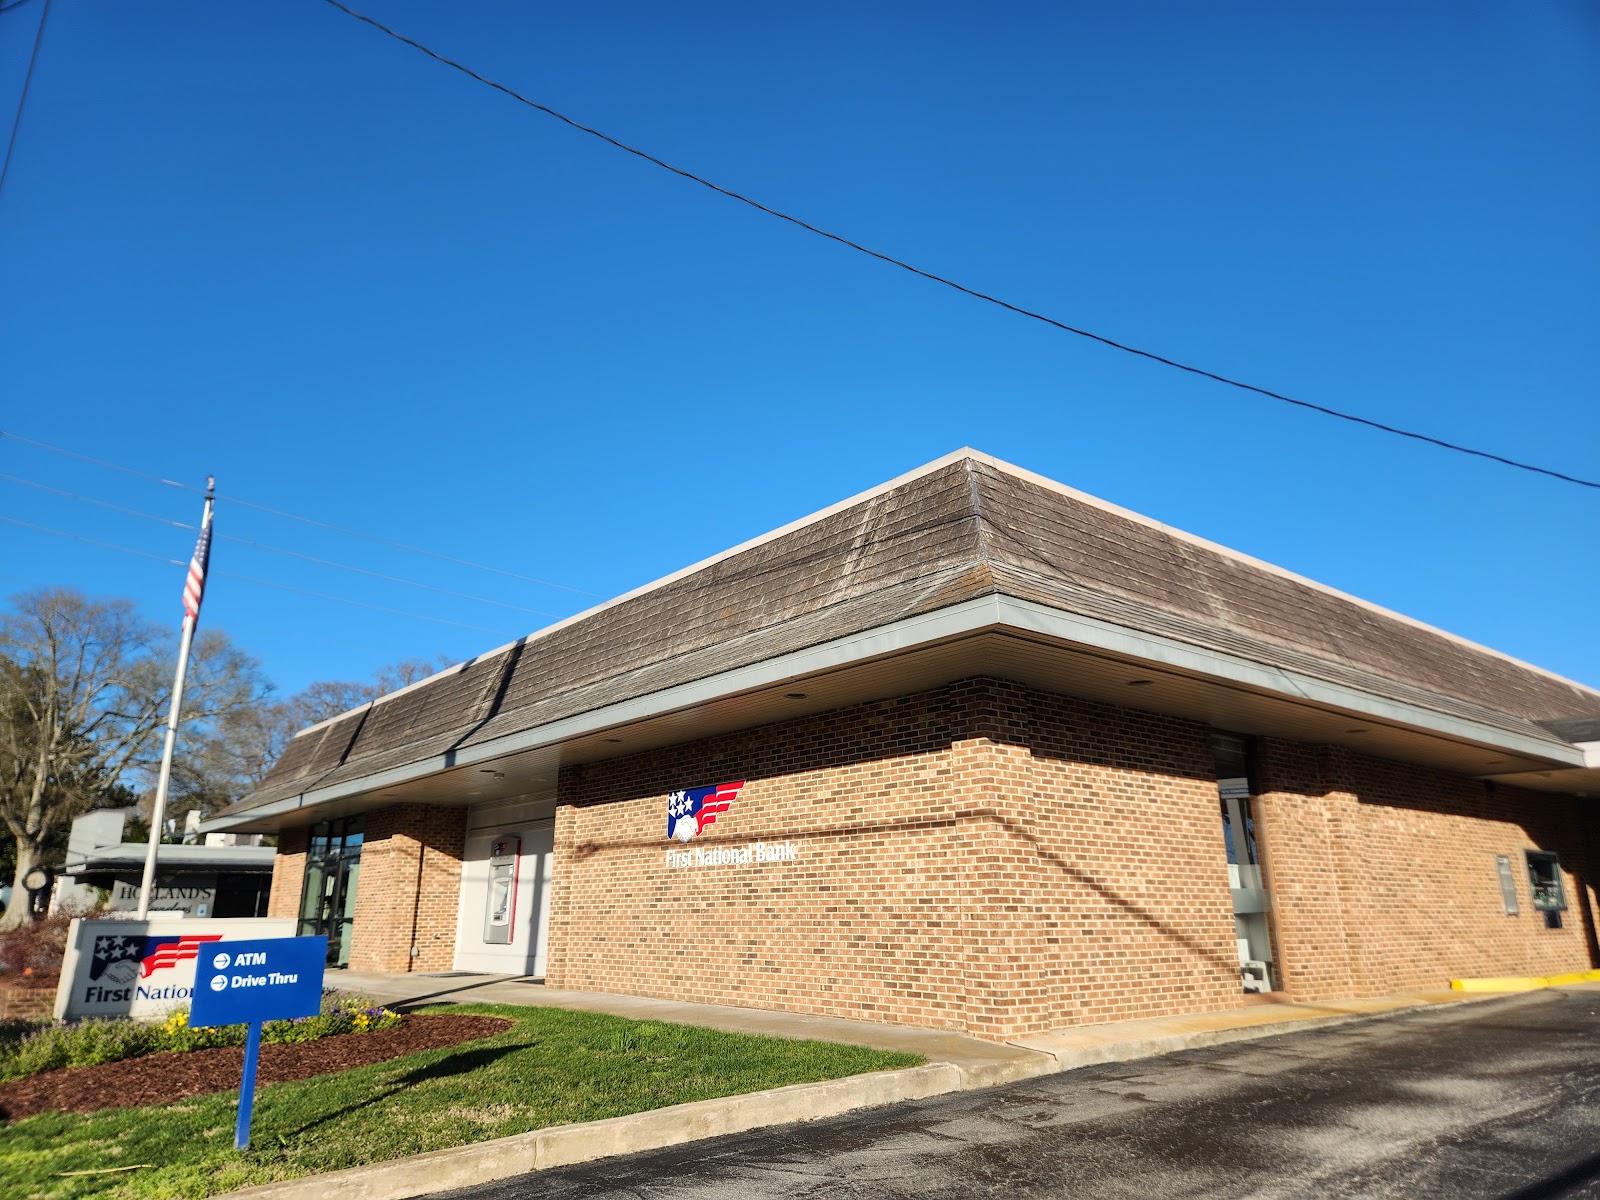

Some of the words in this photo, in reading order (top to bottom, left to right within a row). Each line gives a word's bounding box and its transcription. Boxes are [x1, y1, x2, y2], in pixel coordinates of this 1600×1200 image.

[666, 848, 692, 868] First
[695, 842, 752, 866] National
[756, 839, 796, 862] Bank
[120, 886, 212, 900] HOLAND'S
[234, 952, 266, 967] ATM
[231, 975, 266, 989] Drive
[268, 972, 298, 985] Thru
[85, 986, 131, 1003] First
[135, 984, 194, 1001] Natio
